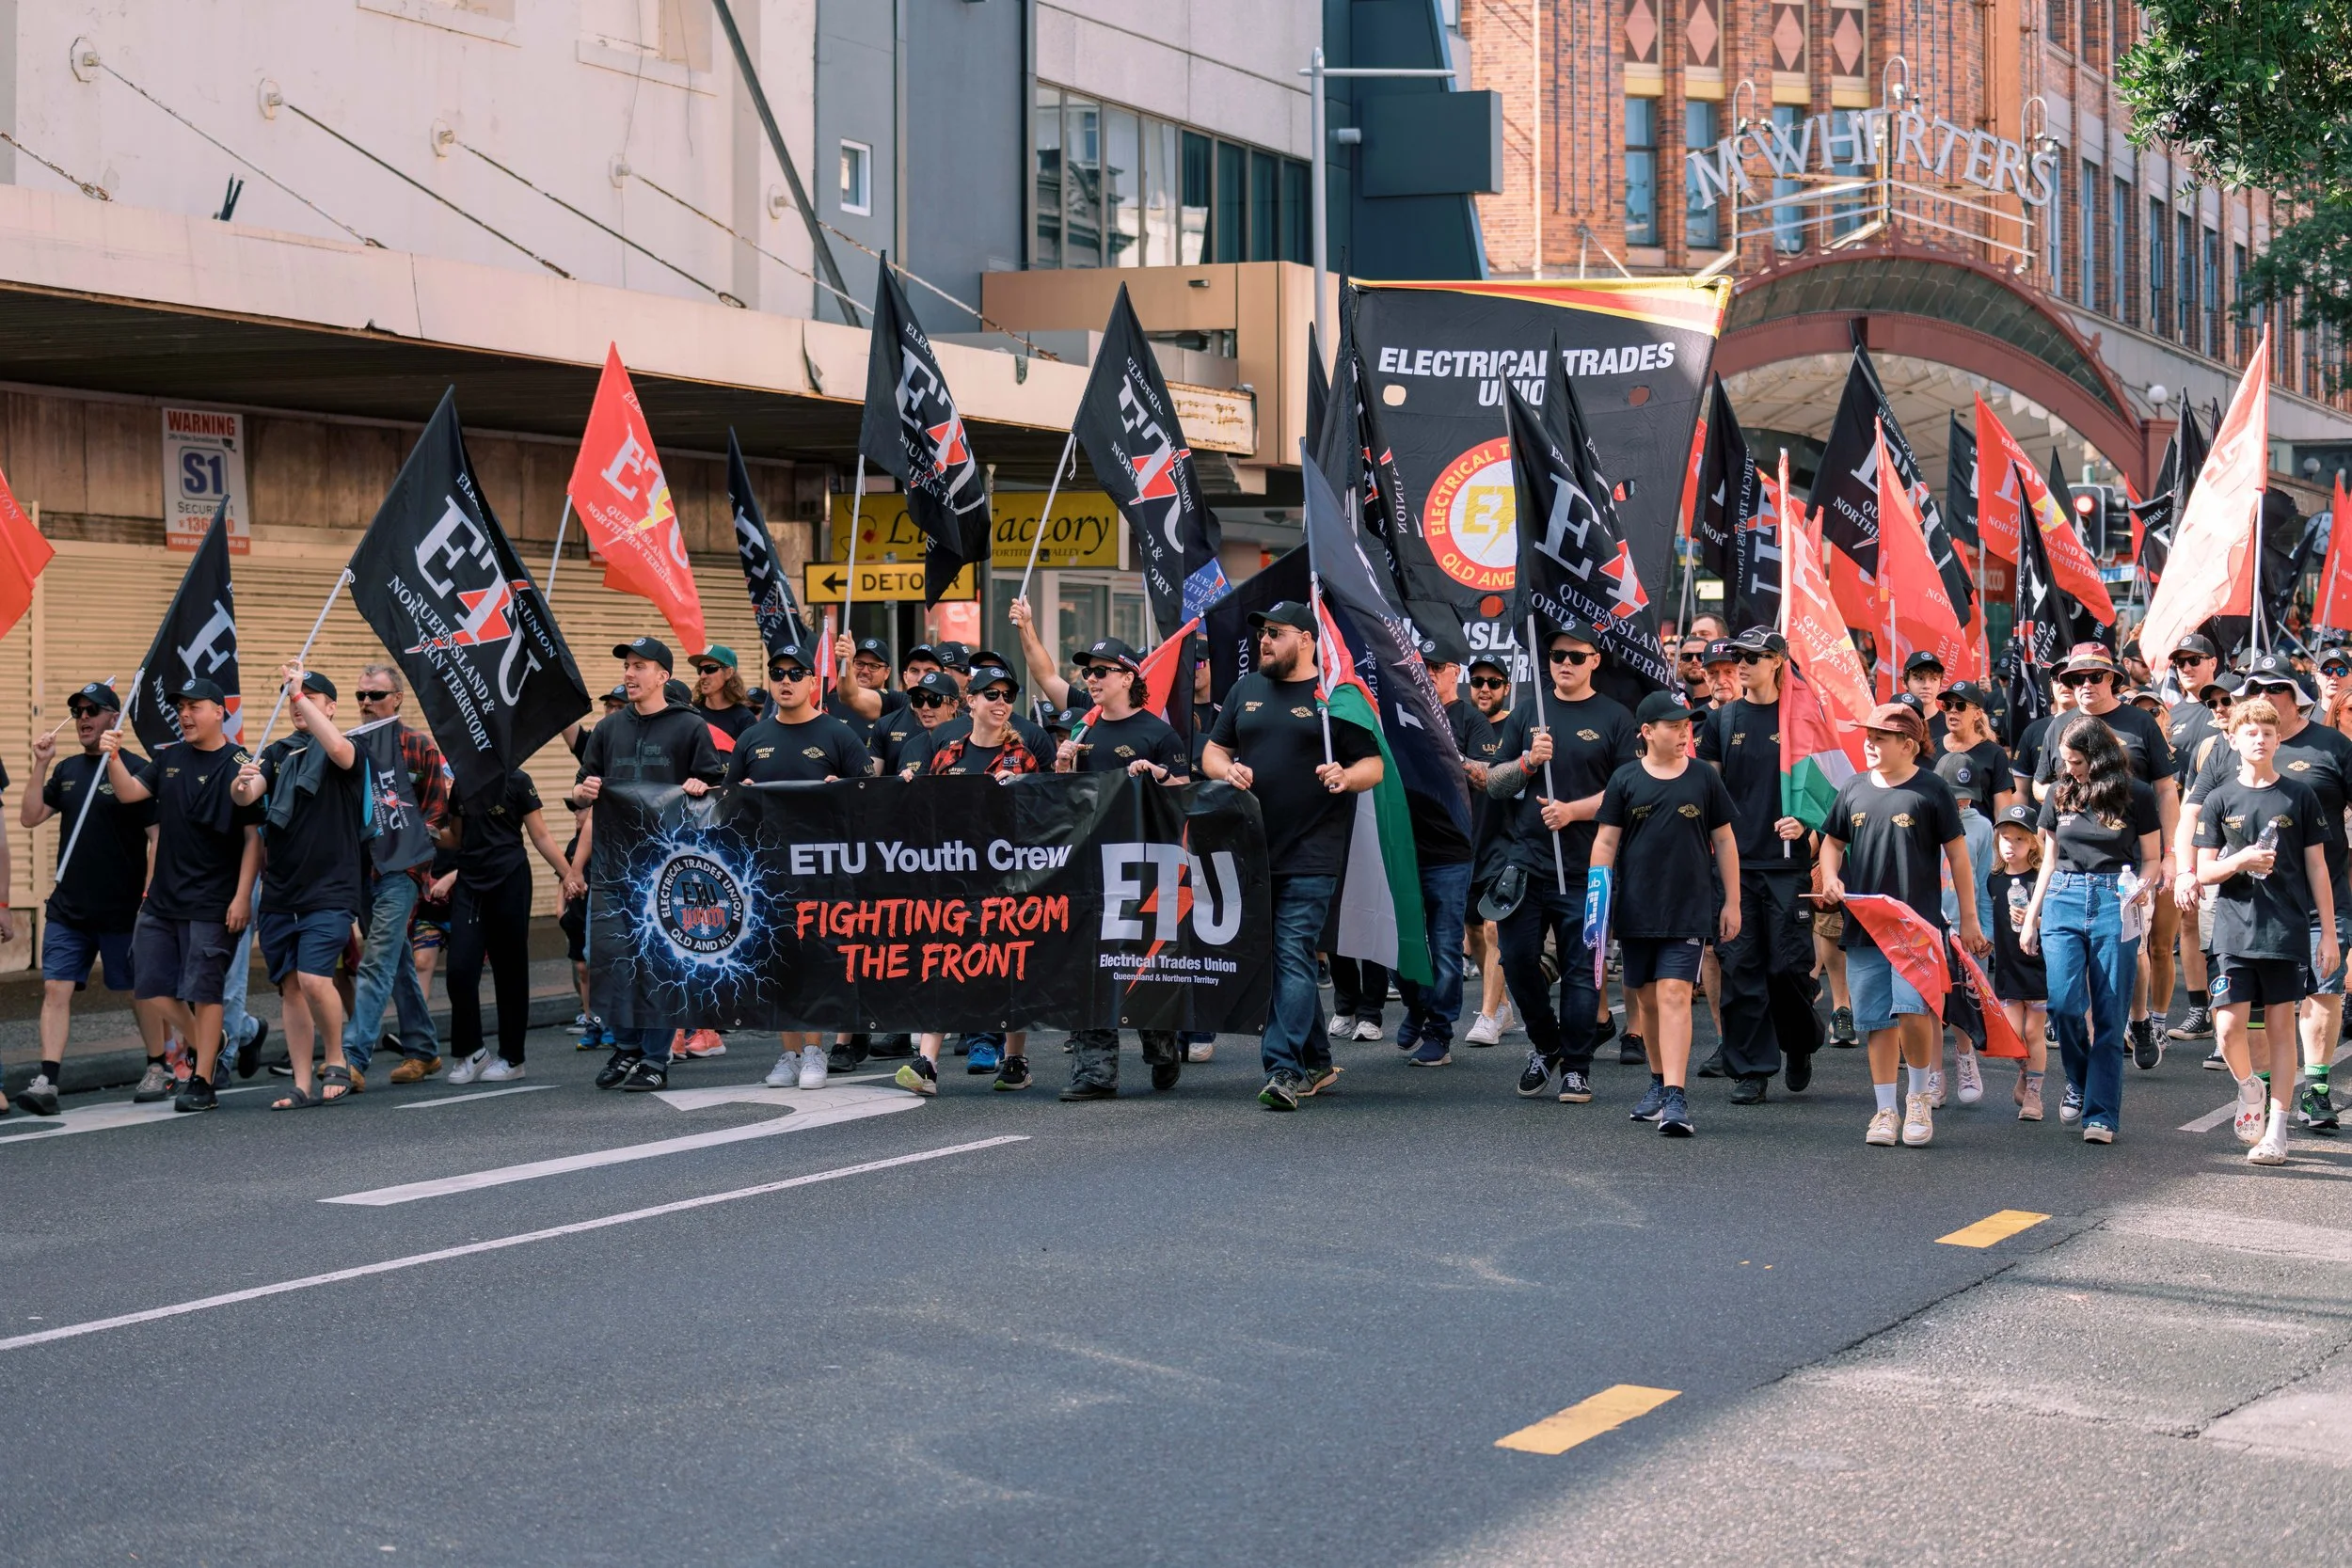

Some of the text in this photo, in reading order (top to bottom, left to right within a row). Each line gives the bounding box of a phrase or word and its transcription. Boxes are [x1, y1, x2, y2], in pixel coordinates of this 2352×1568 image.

[1378, 342, 1676, 377] ELECTRICAL TRADES
[167, 410, 235, 436] WARNING
[183, 452, 223, 495] S1
[1430, 449, 1495, 537] ELECTRICAL
[178, 501, 227, 515] SECURI
[863, 572, 960, 592] DETOR
[1441, 552, 1476, 581] QLD
[523, 611, 557, 658] UNION
[1559, 583, 1662, 658] QUEENSLAN
[416, 593, 495, 715] QUEENSLAND &
[442, 667, 492, 752] TERRITORY
[2225, 816, 2246, 824] MAYDAY
[790, 839, 1073, 875] ETU Youth Crew
[660, 859, 741, 922] ELECTRICAL TRADES UNION
[1101, 843, 1242, 945] ETU
[796, 895, 1069, 939] FIGHTING FROM
[671, 928, 692, 947] QLD
[694, 942, 718, 951] AND
[837, 941, 1035, 983] THE FRONT
[1100, 954, 1237, 973] Electrical Trades Union
[1113, 973, 1153, 982] Queensland
[1162, 974, 1191, 983] Northern
[1194, 975, 1219, 986] Territory
